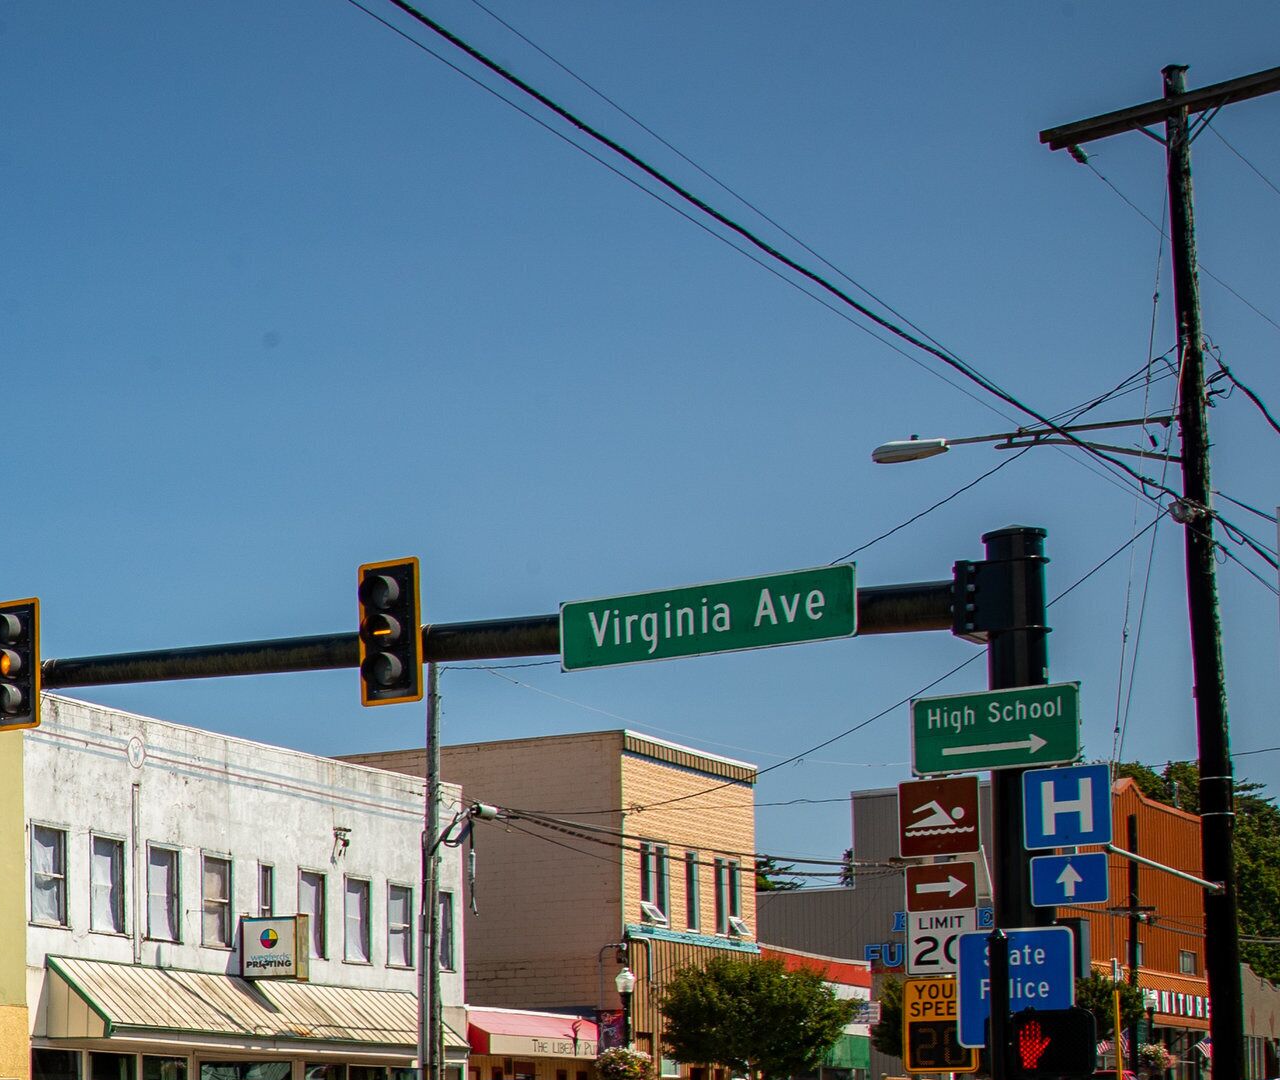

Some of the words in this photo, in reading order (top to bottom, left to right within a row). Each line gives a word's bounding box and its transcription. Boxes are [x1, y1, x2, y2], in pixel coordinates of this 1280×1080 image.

[588, 597, 731, 654] Virginia
[753, 588, 826, 627] Ave
[928, 705, 976, 733] High
[988, 696, 1062, 723] School
[1041, 777, 1094, 836] H
[918, 915, 965, 930] LIMIT
[984, 944, 1046, 967] ate
[914, 983, 957, 999] YOU
[980, 978, 1050, 1000] Plice
[910, 1001, 957, 1017] SPEE
[552, 1042, 582, 1054] LIBERY
[584, 1042, 596, 1056] PU
